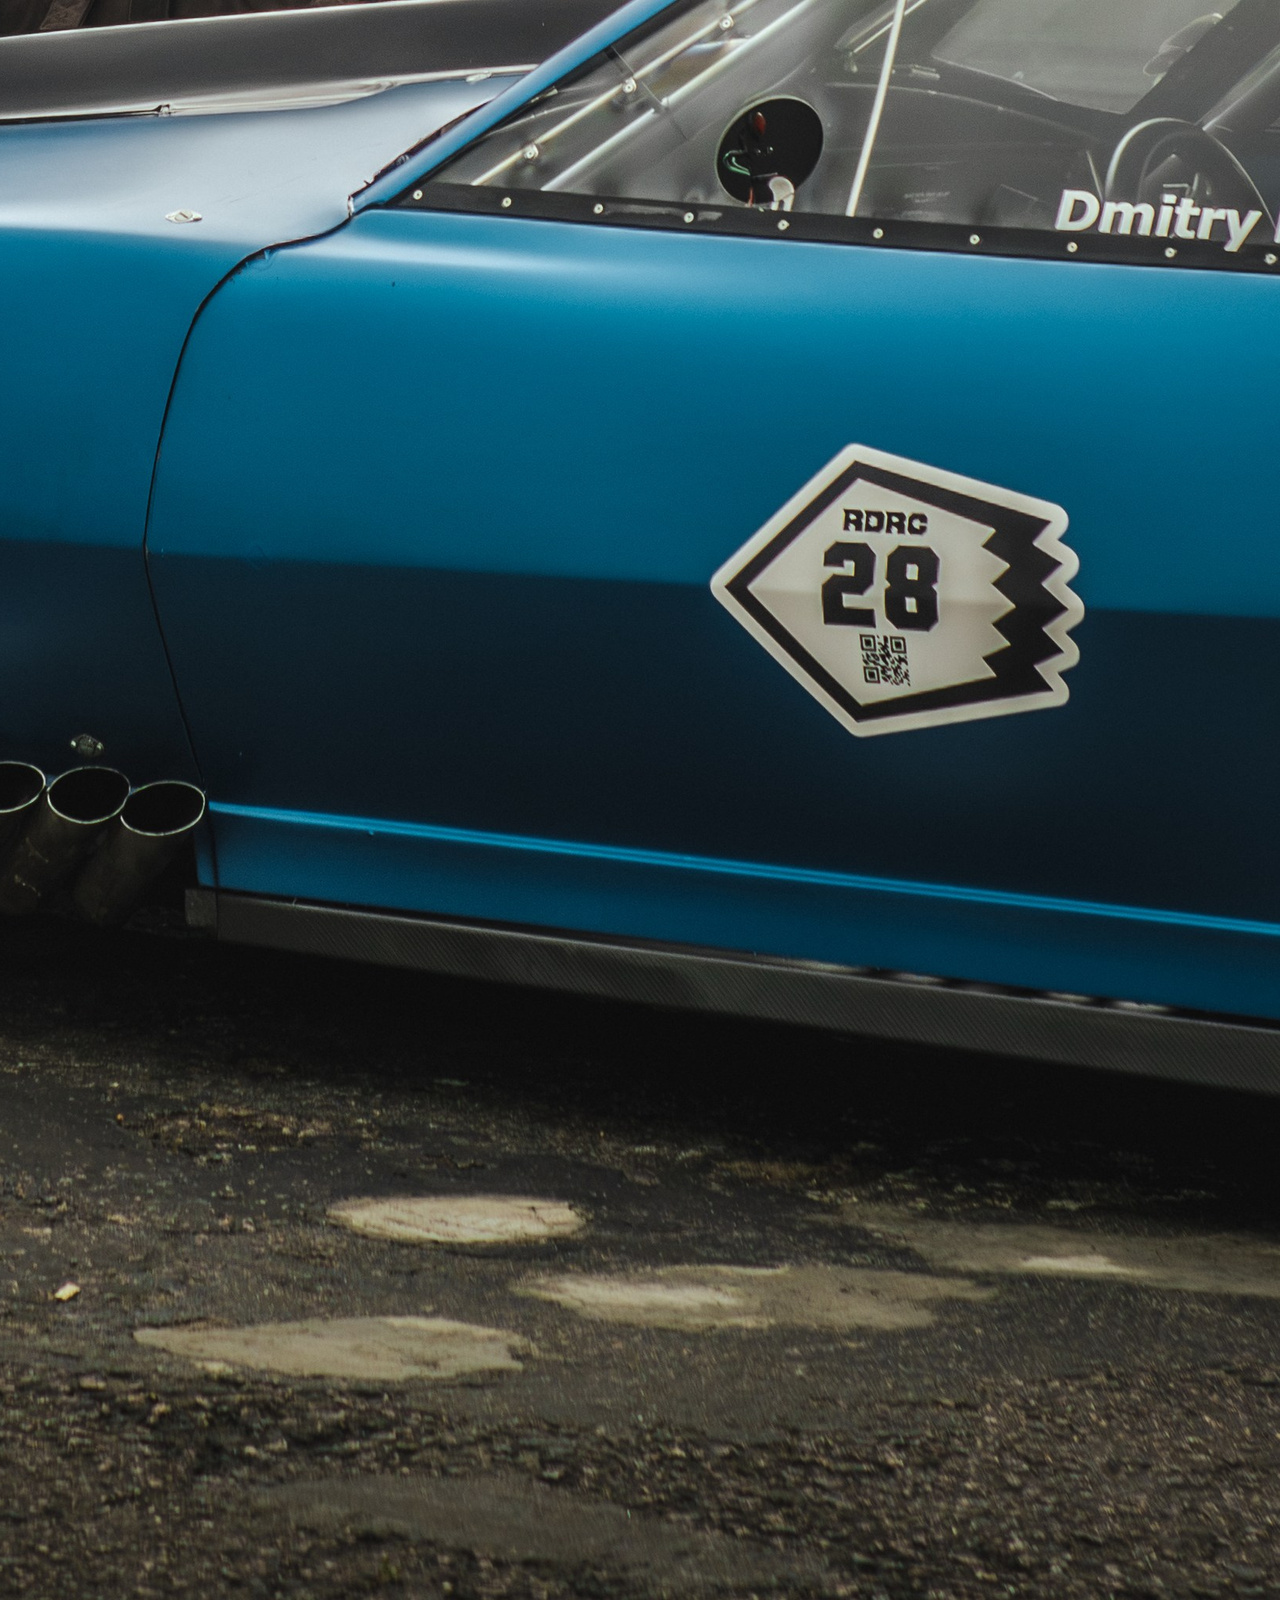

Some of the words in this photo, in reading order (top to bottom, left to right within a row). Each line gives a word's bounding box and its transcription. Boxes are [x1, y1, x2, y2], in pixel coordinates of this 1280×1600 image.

[1054, 189, 1263, 253] Dmitry
[842, 508, 929, 536] RDRC
[820, 541, 941, 632] 28
